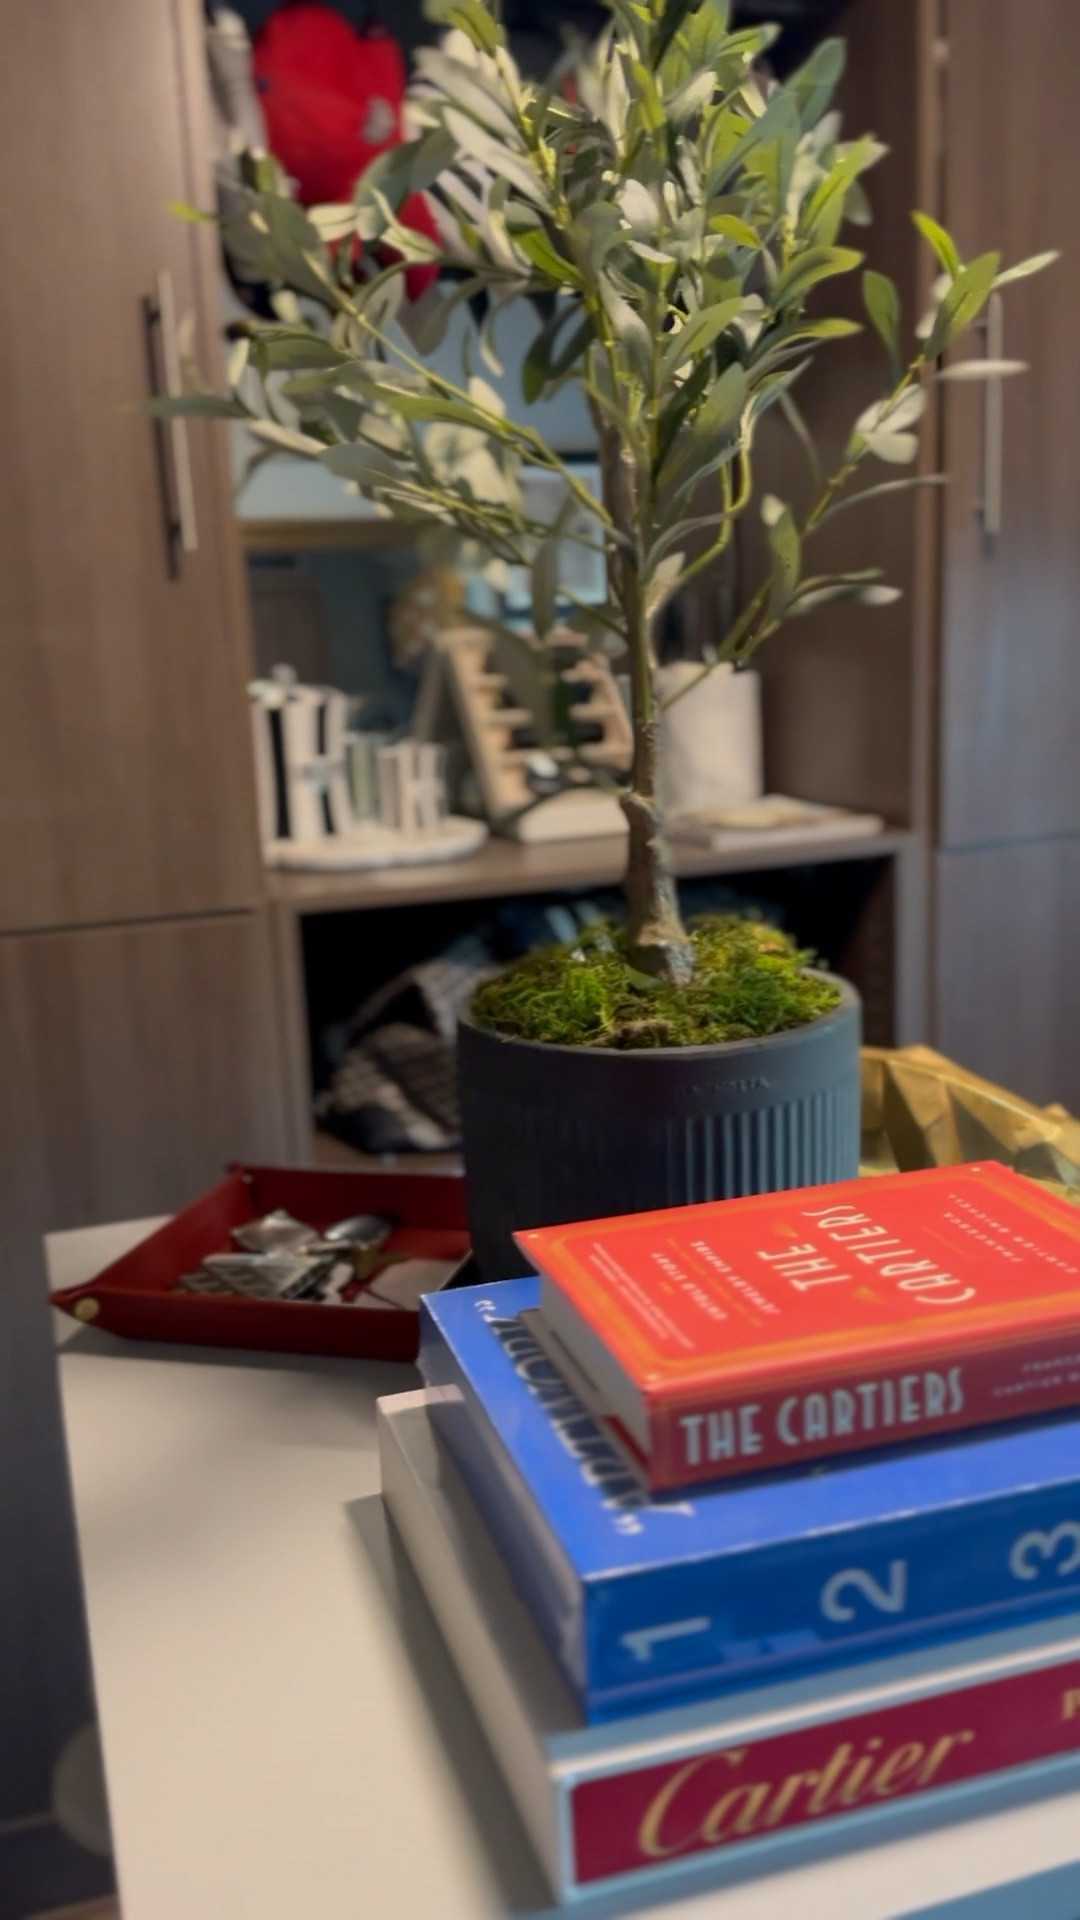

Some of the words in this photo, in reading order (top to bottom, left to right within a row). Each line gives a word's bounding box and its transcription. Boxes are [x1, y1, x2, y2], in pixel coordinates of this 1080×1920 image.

[757, 1244, 855, 1291] THE
[801, 1204, 977, 1306] CARTIERS
[680, 1404, 762, 1465] THE
[776, 1367, 964, 1446] CARTIERS
[1008, 1520, 1080, 1581] 3
[820, 1560, 908, 1622] 2
[621, 1616, 711, 1663] 1
[638, 1730, 976, 1857] Cartier
